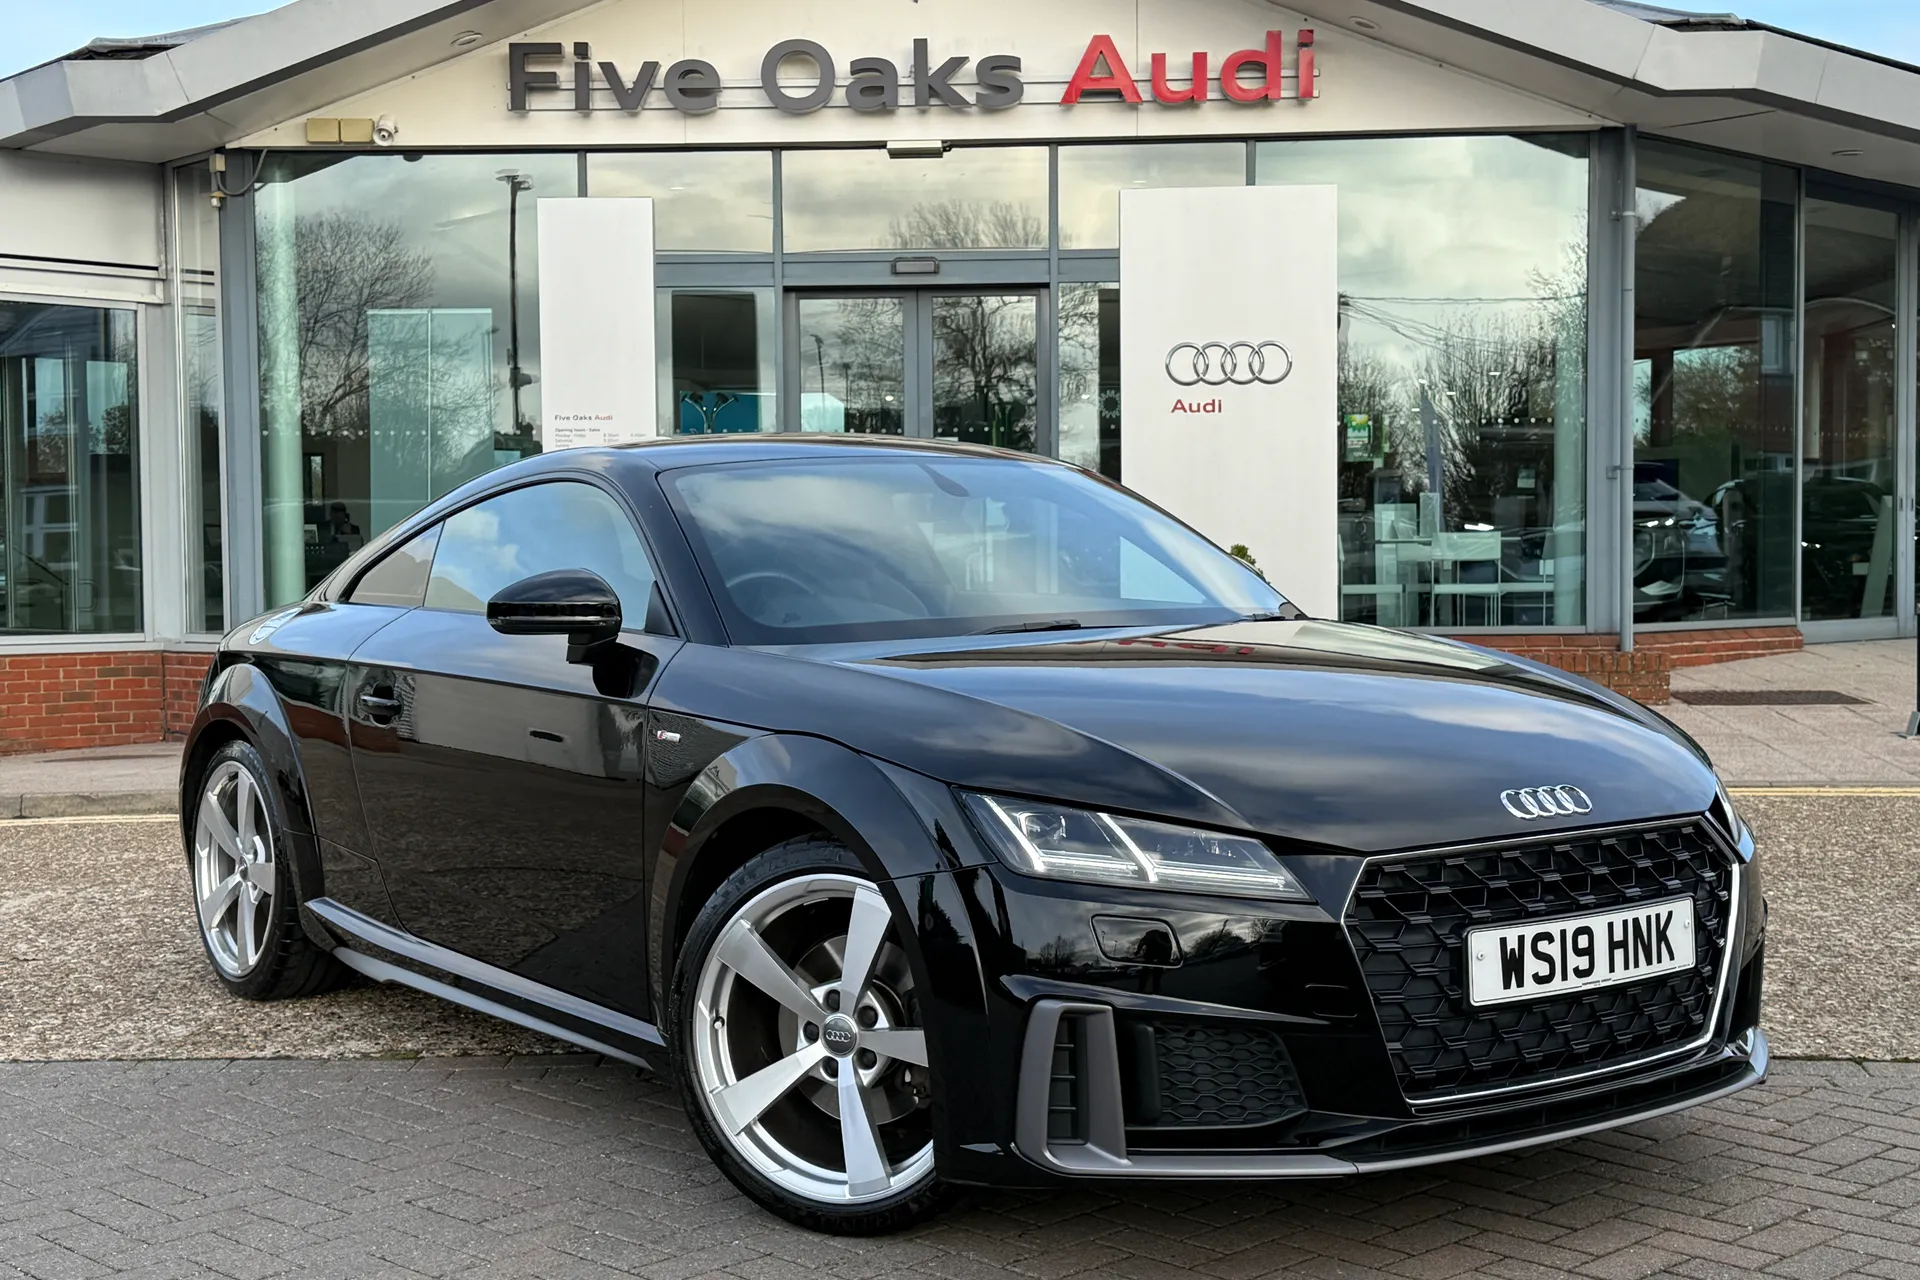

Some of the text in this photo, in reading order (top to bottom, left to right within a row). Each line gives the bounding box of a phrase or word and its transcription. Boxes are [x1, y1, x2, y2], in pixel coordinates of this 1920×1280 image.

[507, 28, 1315, 114] Five Oaks Audi
[1170, 398, 1223, 414] Audi
[1499, 909, 1676, 991] WS19 HNK
